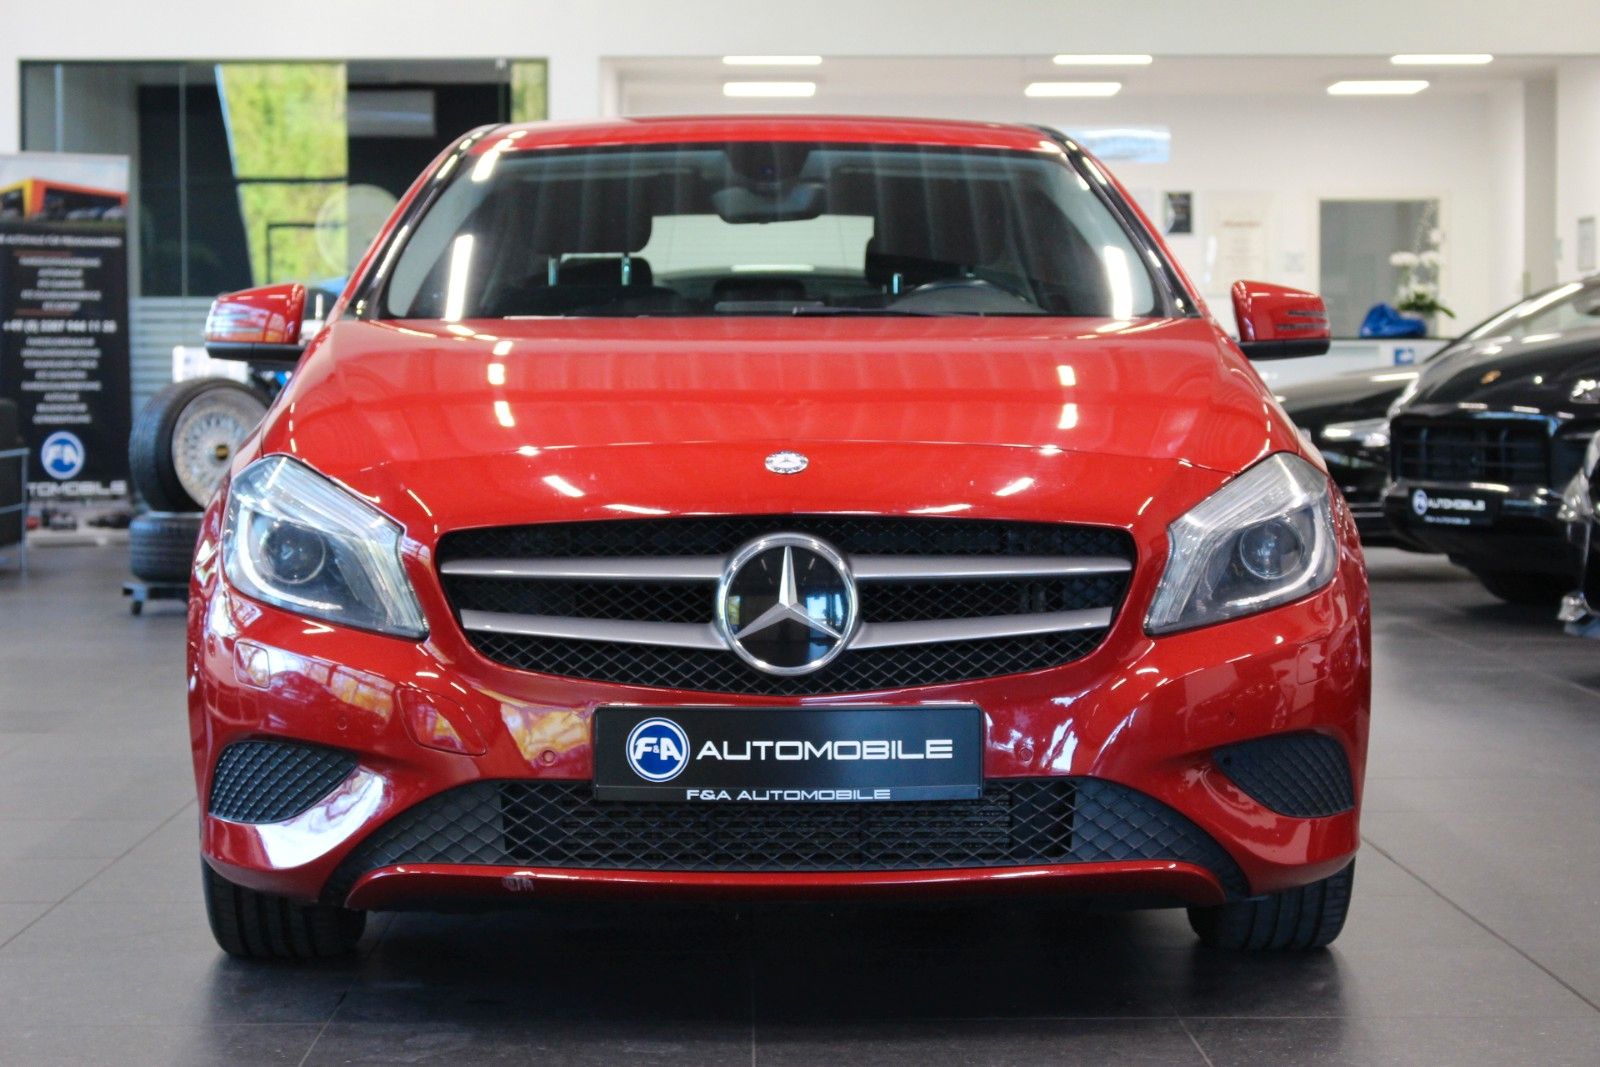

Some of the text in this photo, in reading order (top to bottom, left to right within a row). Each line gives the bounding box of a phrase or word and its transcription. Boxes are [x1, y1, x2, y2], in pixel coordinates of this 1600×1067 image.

[634, 737, 953, 761] F&A AUTOMOBILE
[686, 788, 891, 801] F&A AUTOMOBILE
